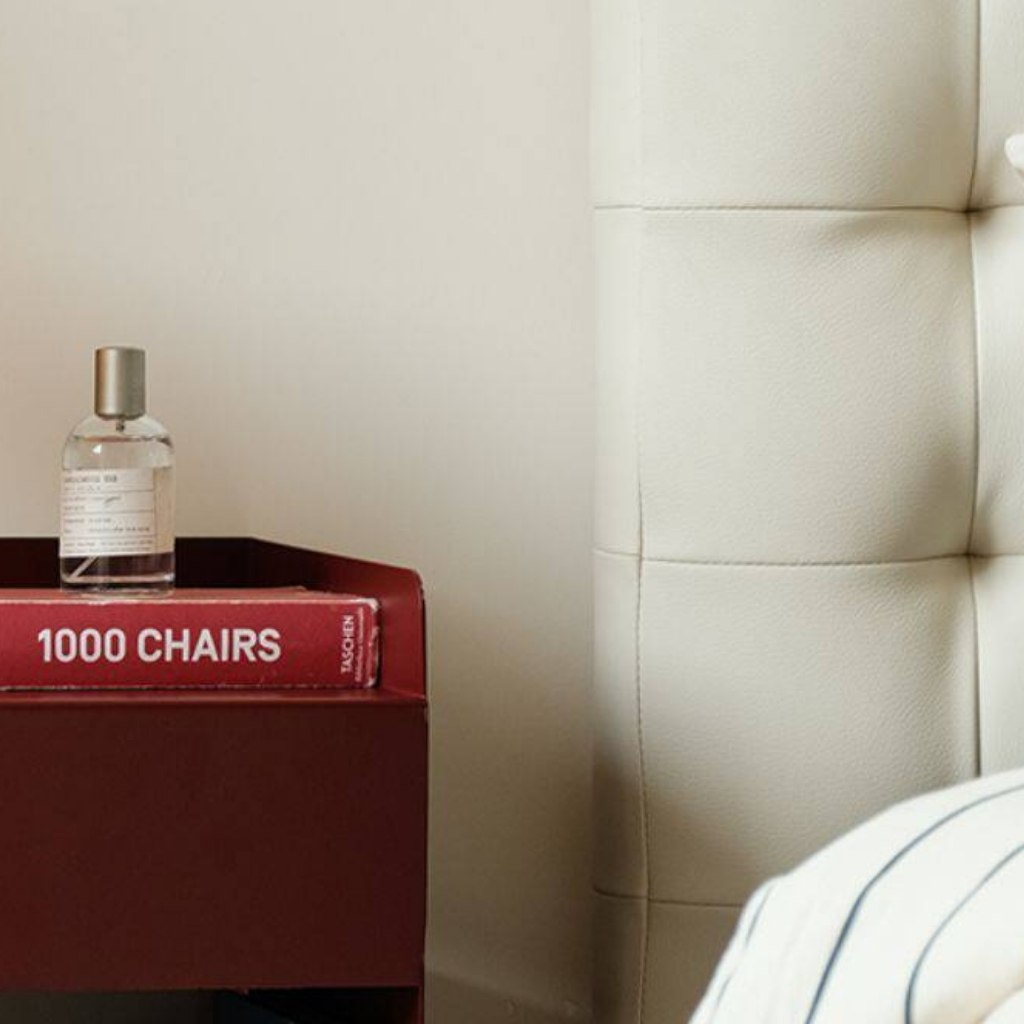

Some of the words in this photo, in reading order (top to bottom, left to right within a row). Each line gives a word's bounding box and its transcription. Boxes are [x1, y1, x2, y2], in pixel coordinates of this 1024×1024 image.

[37, 628, 126, 663] 1000
[137, 628, 282, 663] CHAIRS
[340, 614, 355, 674] TASCHEN
